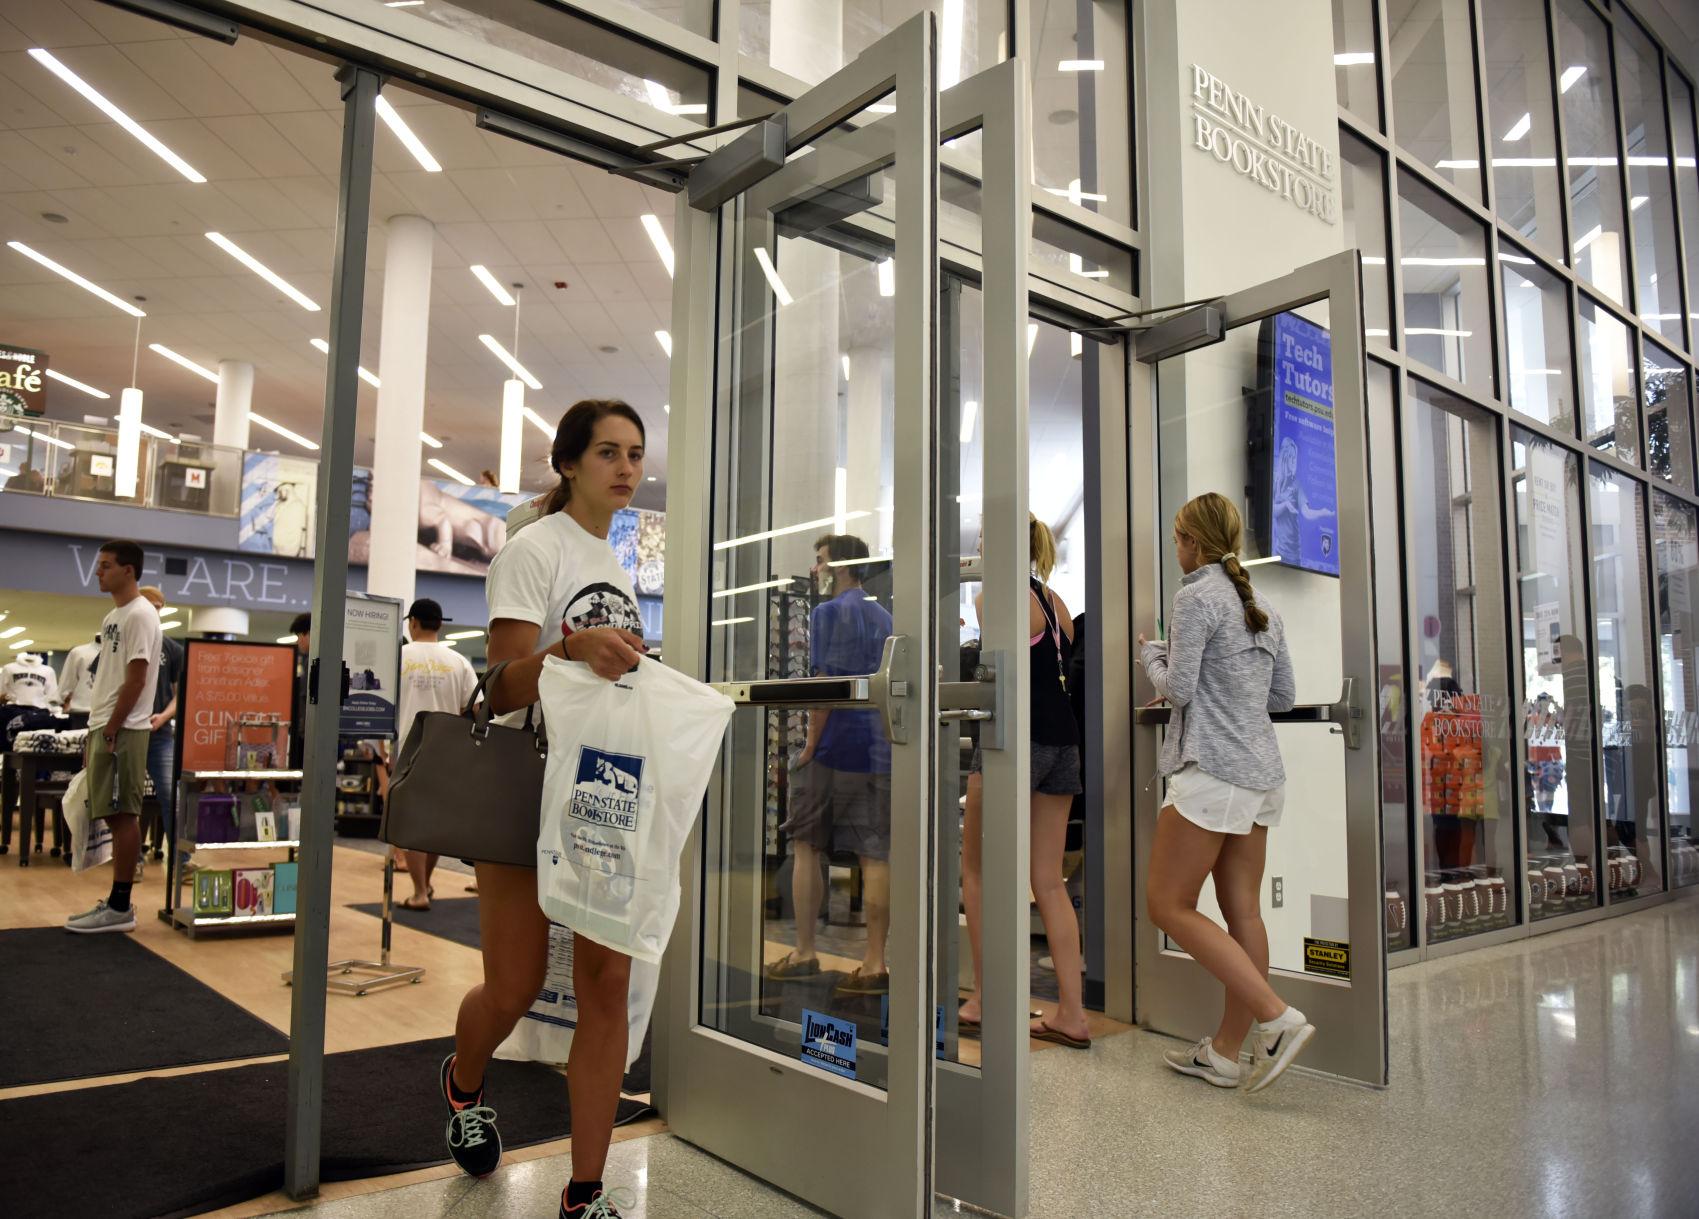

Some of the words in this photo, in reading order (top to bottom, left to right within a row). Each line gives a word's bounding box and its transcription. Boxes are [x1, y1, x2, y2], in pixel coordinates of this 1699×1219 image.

[1191, 63, 1264, 137] PENN
[1267, 114, 1333, 181] STATE
[1193, 113, 1335, 225] BOOKSTORE
[1282, 333, 1324, 372] Tech
[0, 364, 42, 393] afé
[1282, 361, 1334, 401] Tutors
[347, 608, 364, 617] NOW
[1433, 689, 1464, 708] PENN
[1465, 694, 1495, 713] STATE
[194, 728, 225, 745] GIF
[1434, 717, 1497, 738] BOOKSTORE
[1309, 949, 1344, 960] STANLEY
[806, 1048, 834, 1063] ACCEPTED
[835, 1057, 851, 1068] HERE
